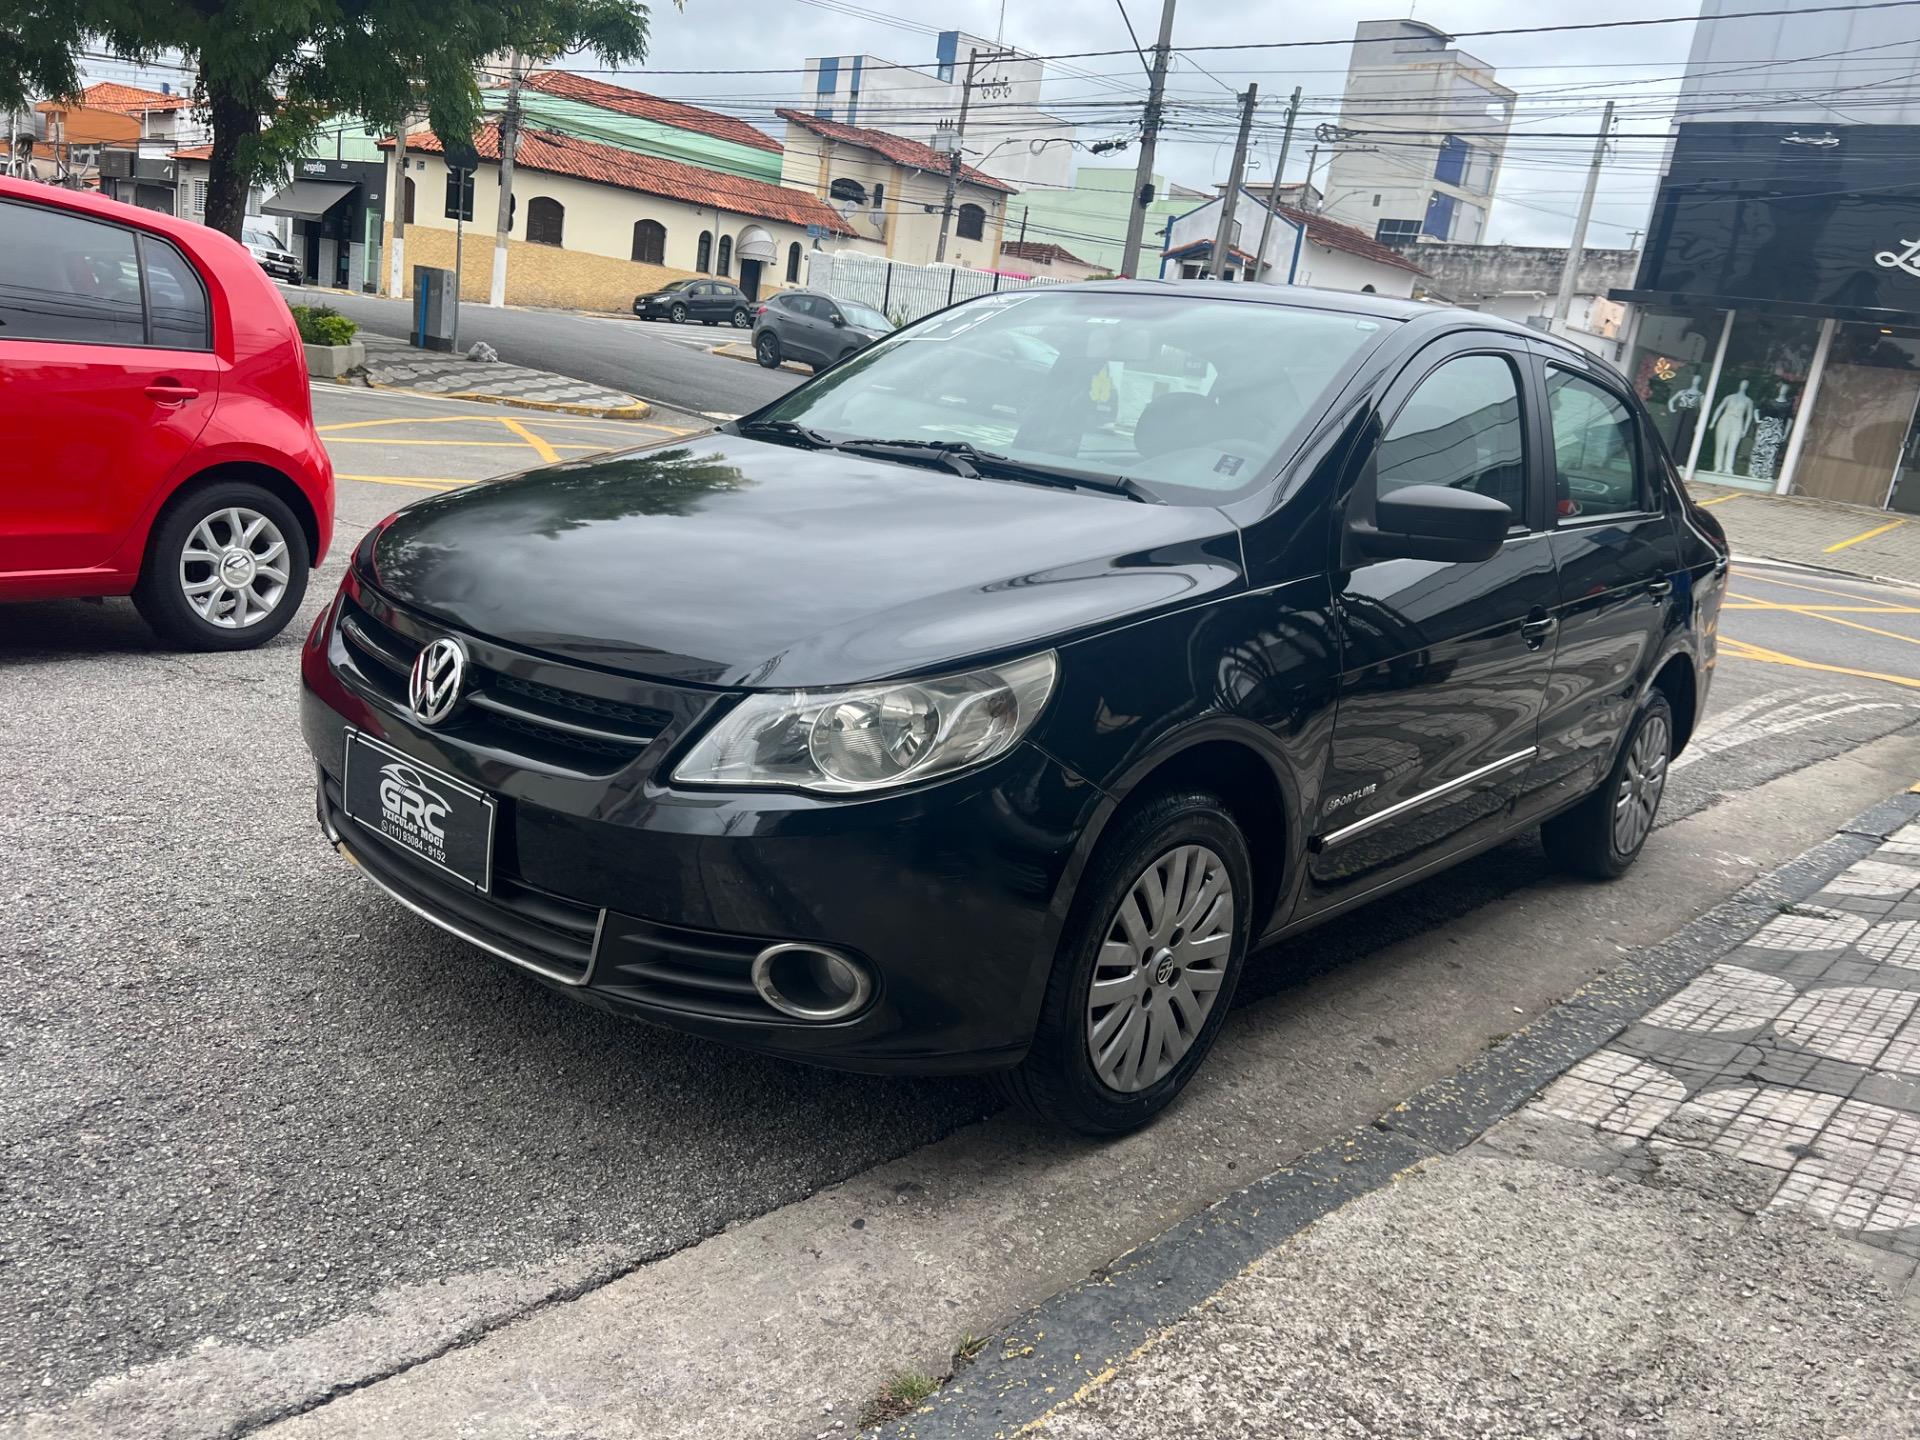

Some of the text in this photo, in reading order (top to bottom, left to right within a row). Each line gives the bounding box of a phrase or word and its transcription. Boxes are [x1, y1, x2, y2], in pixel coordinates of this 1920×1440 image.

[380, 779, 446, 839] GRC
[382, 807, 444, 848] VEICULOS MOGI
[389, 823, 402, 840] (11)
